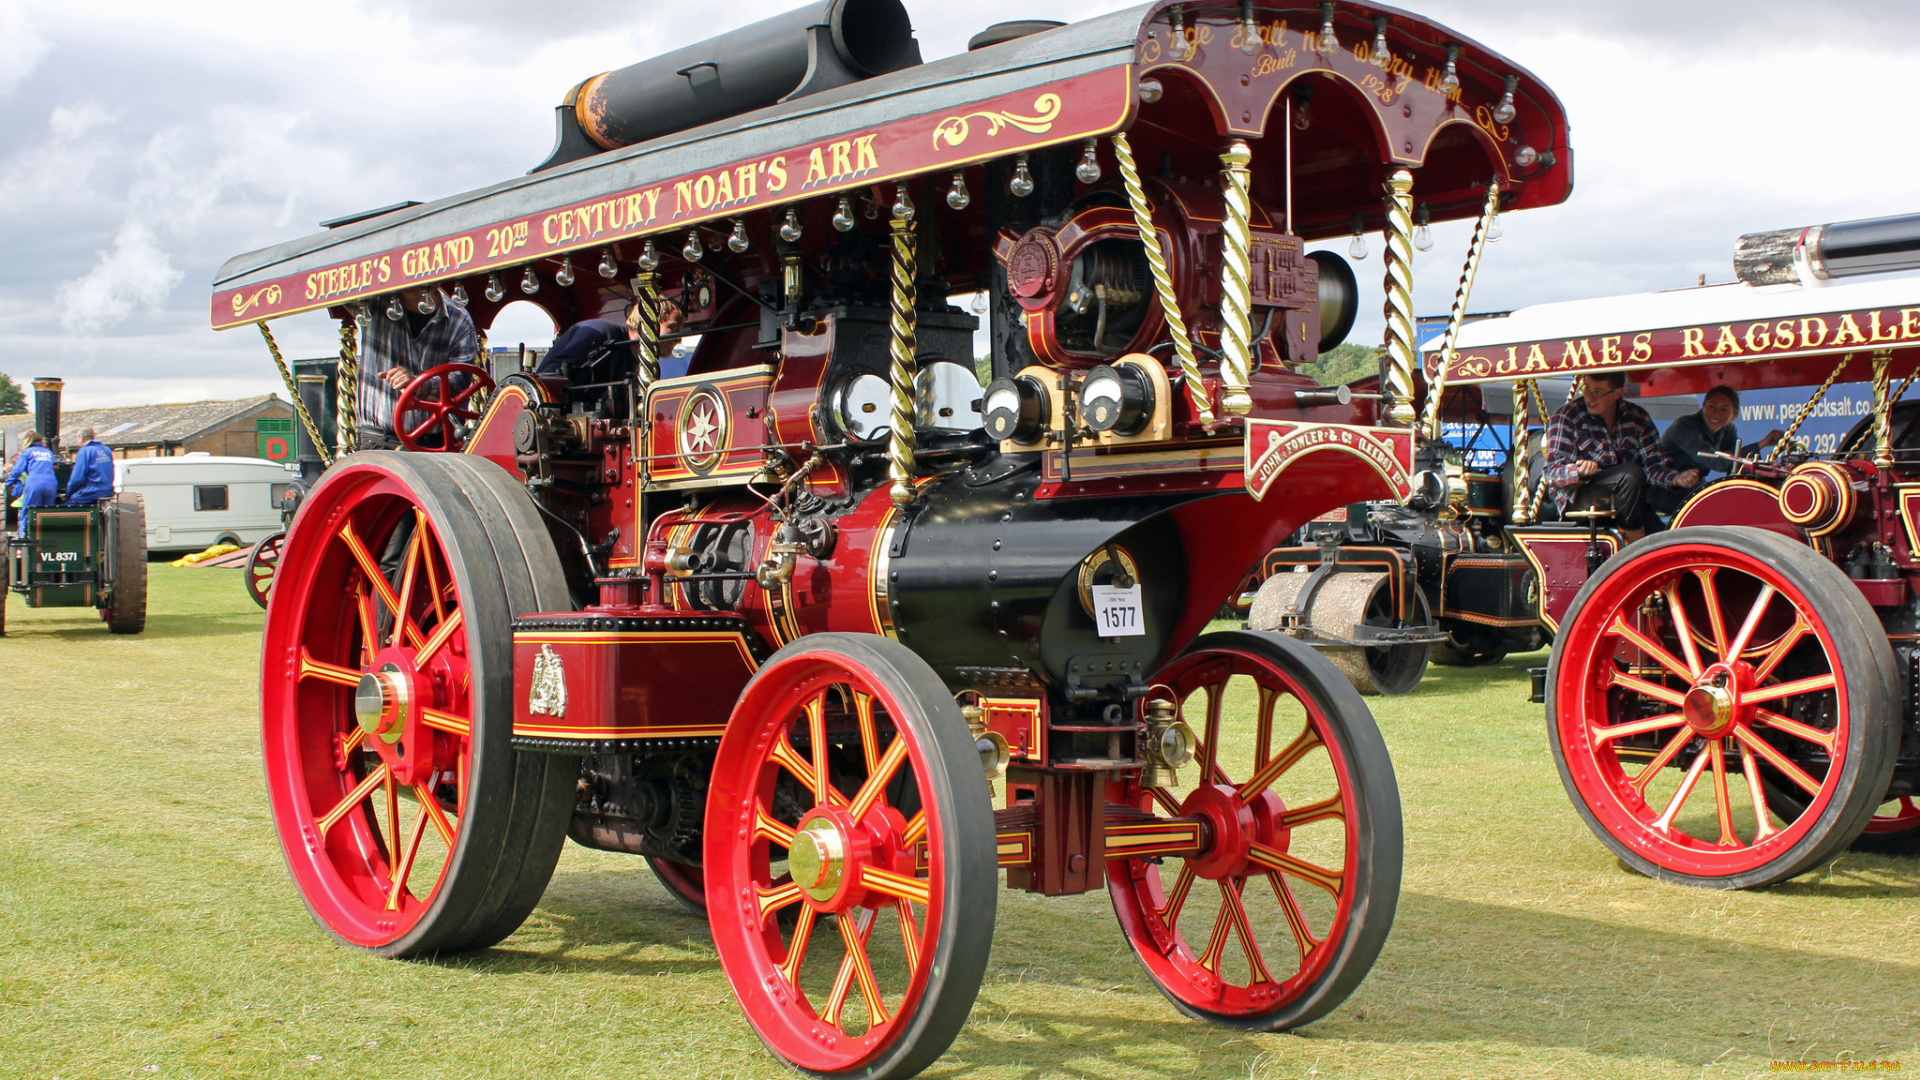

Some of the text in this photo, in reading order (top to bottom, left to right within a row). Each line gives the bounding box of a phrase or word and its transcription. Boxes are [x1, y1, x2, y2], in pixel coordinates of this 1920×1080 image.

[1303, 30, 1338, 53] no
[1252, 48, 1297, 78] Built
[1361, 73, 1393, 103] 1928
[305, 254, 392, 300] STEELE'S
[401, 235, 475, 279] GRAND
[542, 187, 662, 246] CENTURY
[672, 156, 788, 218] NOAH'S
[802, 133, 880, 189] ARK
[1497, 307, 1920, 374] JAMES RAGSDALE
[1741, 396, 1874, 424] www.peaocksalt.co.
[267, 438, 288, 460] D
[1260, 449, 1282, 482] JOHN
[1285, 430, 1324, 452] FOWLER
[1329, 429, 1339, 441] &
[1358, 438, 1392, 472] (LEEDS)
[40, 551, 78, 562] VL 8371
[1102, 606, 1136, 628] 1577
